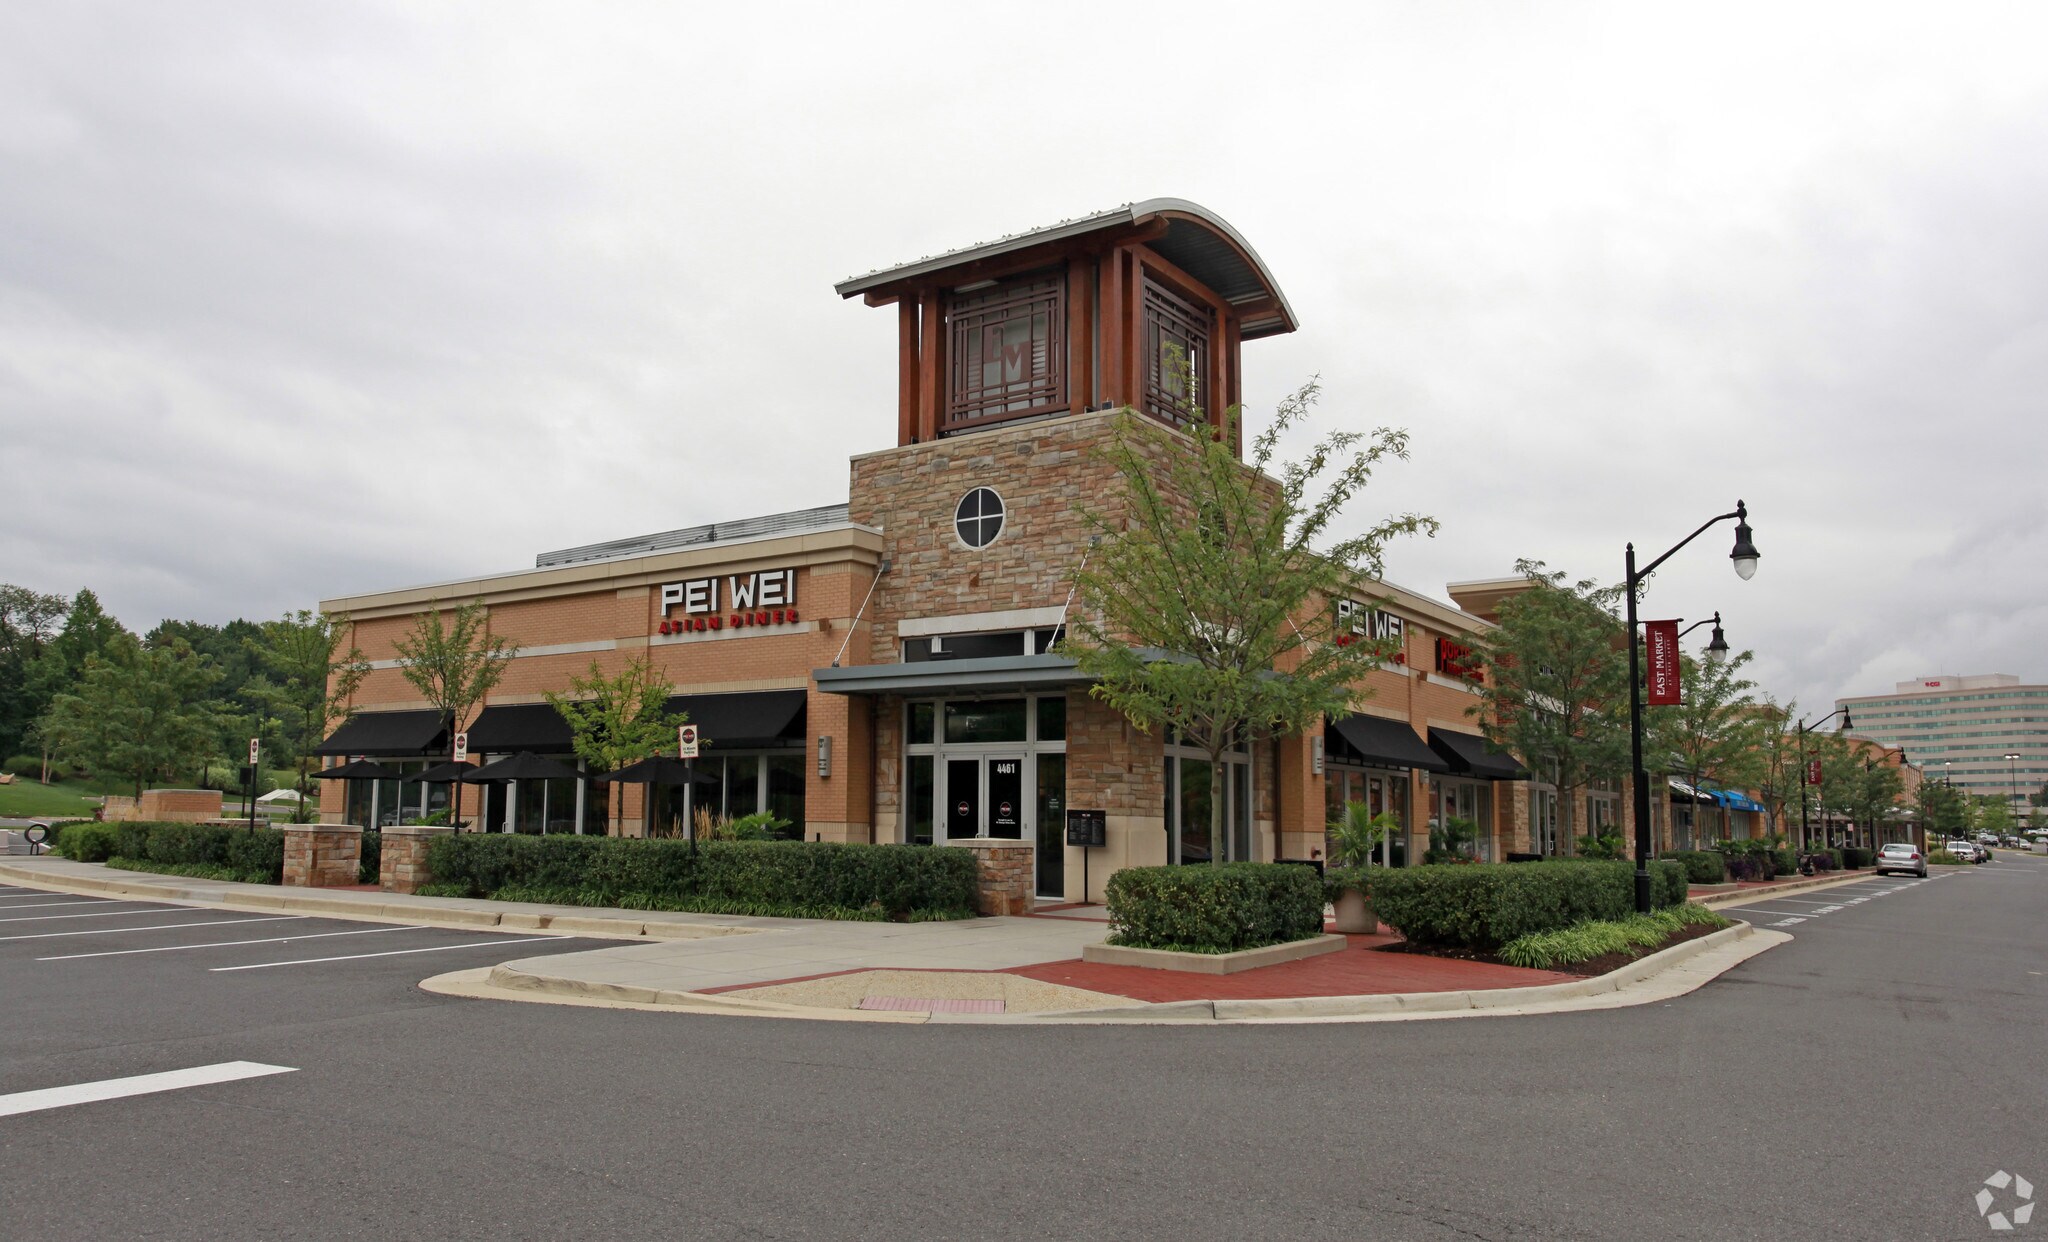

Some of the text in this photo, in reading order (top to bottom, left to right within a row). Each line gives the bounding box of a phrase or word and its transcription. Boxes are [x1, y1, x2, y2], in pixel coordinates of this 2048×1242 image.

[661, 569, 794, 616] PEI WEI
[658, 608, 797, 634] ASIAN DINER
[1654, 630, 1666, 696] EAST MARKET
[997, 763, 1015, 774] 4461
